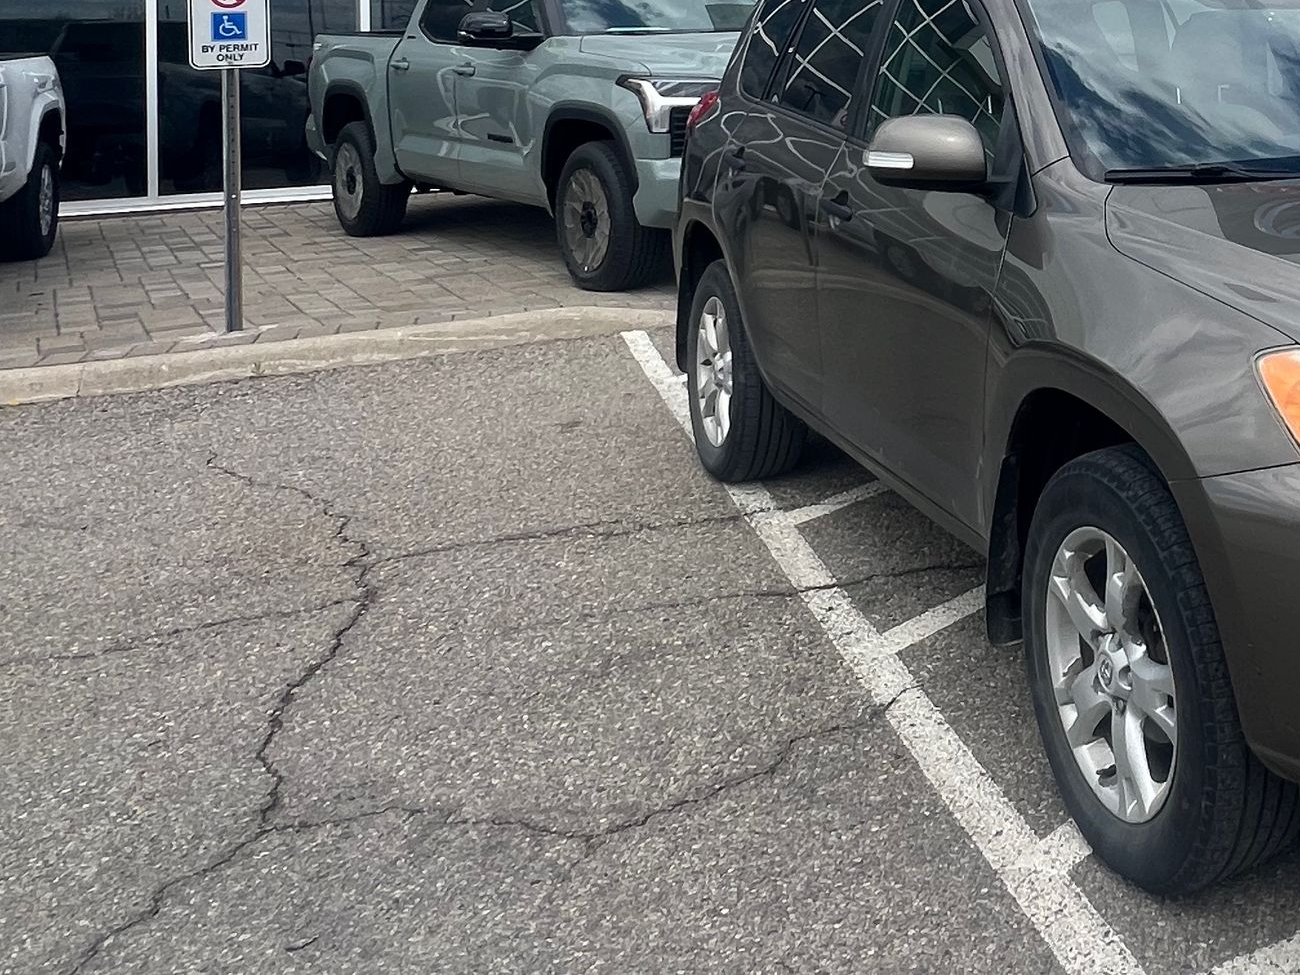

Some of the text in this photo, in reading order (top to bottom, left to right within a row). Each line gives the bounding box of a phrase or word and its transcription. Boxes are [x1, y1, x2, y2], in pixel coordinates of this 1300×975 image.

[201, 43, 259, 53] BY PERMIT
[216, 53, 245, 62] ONLY
